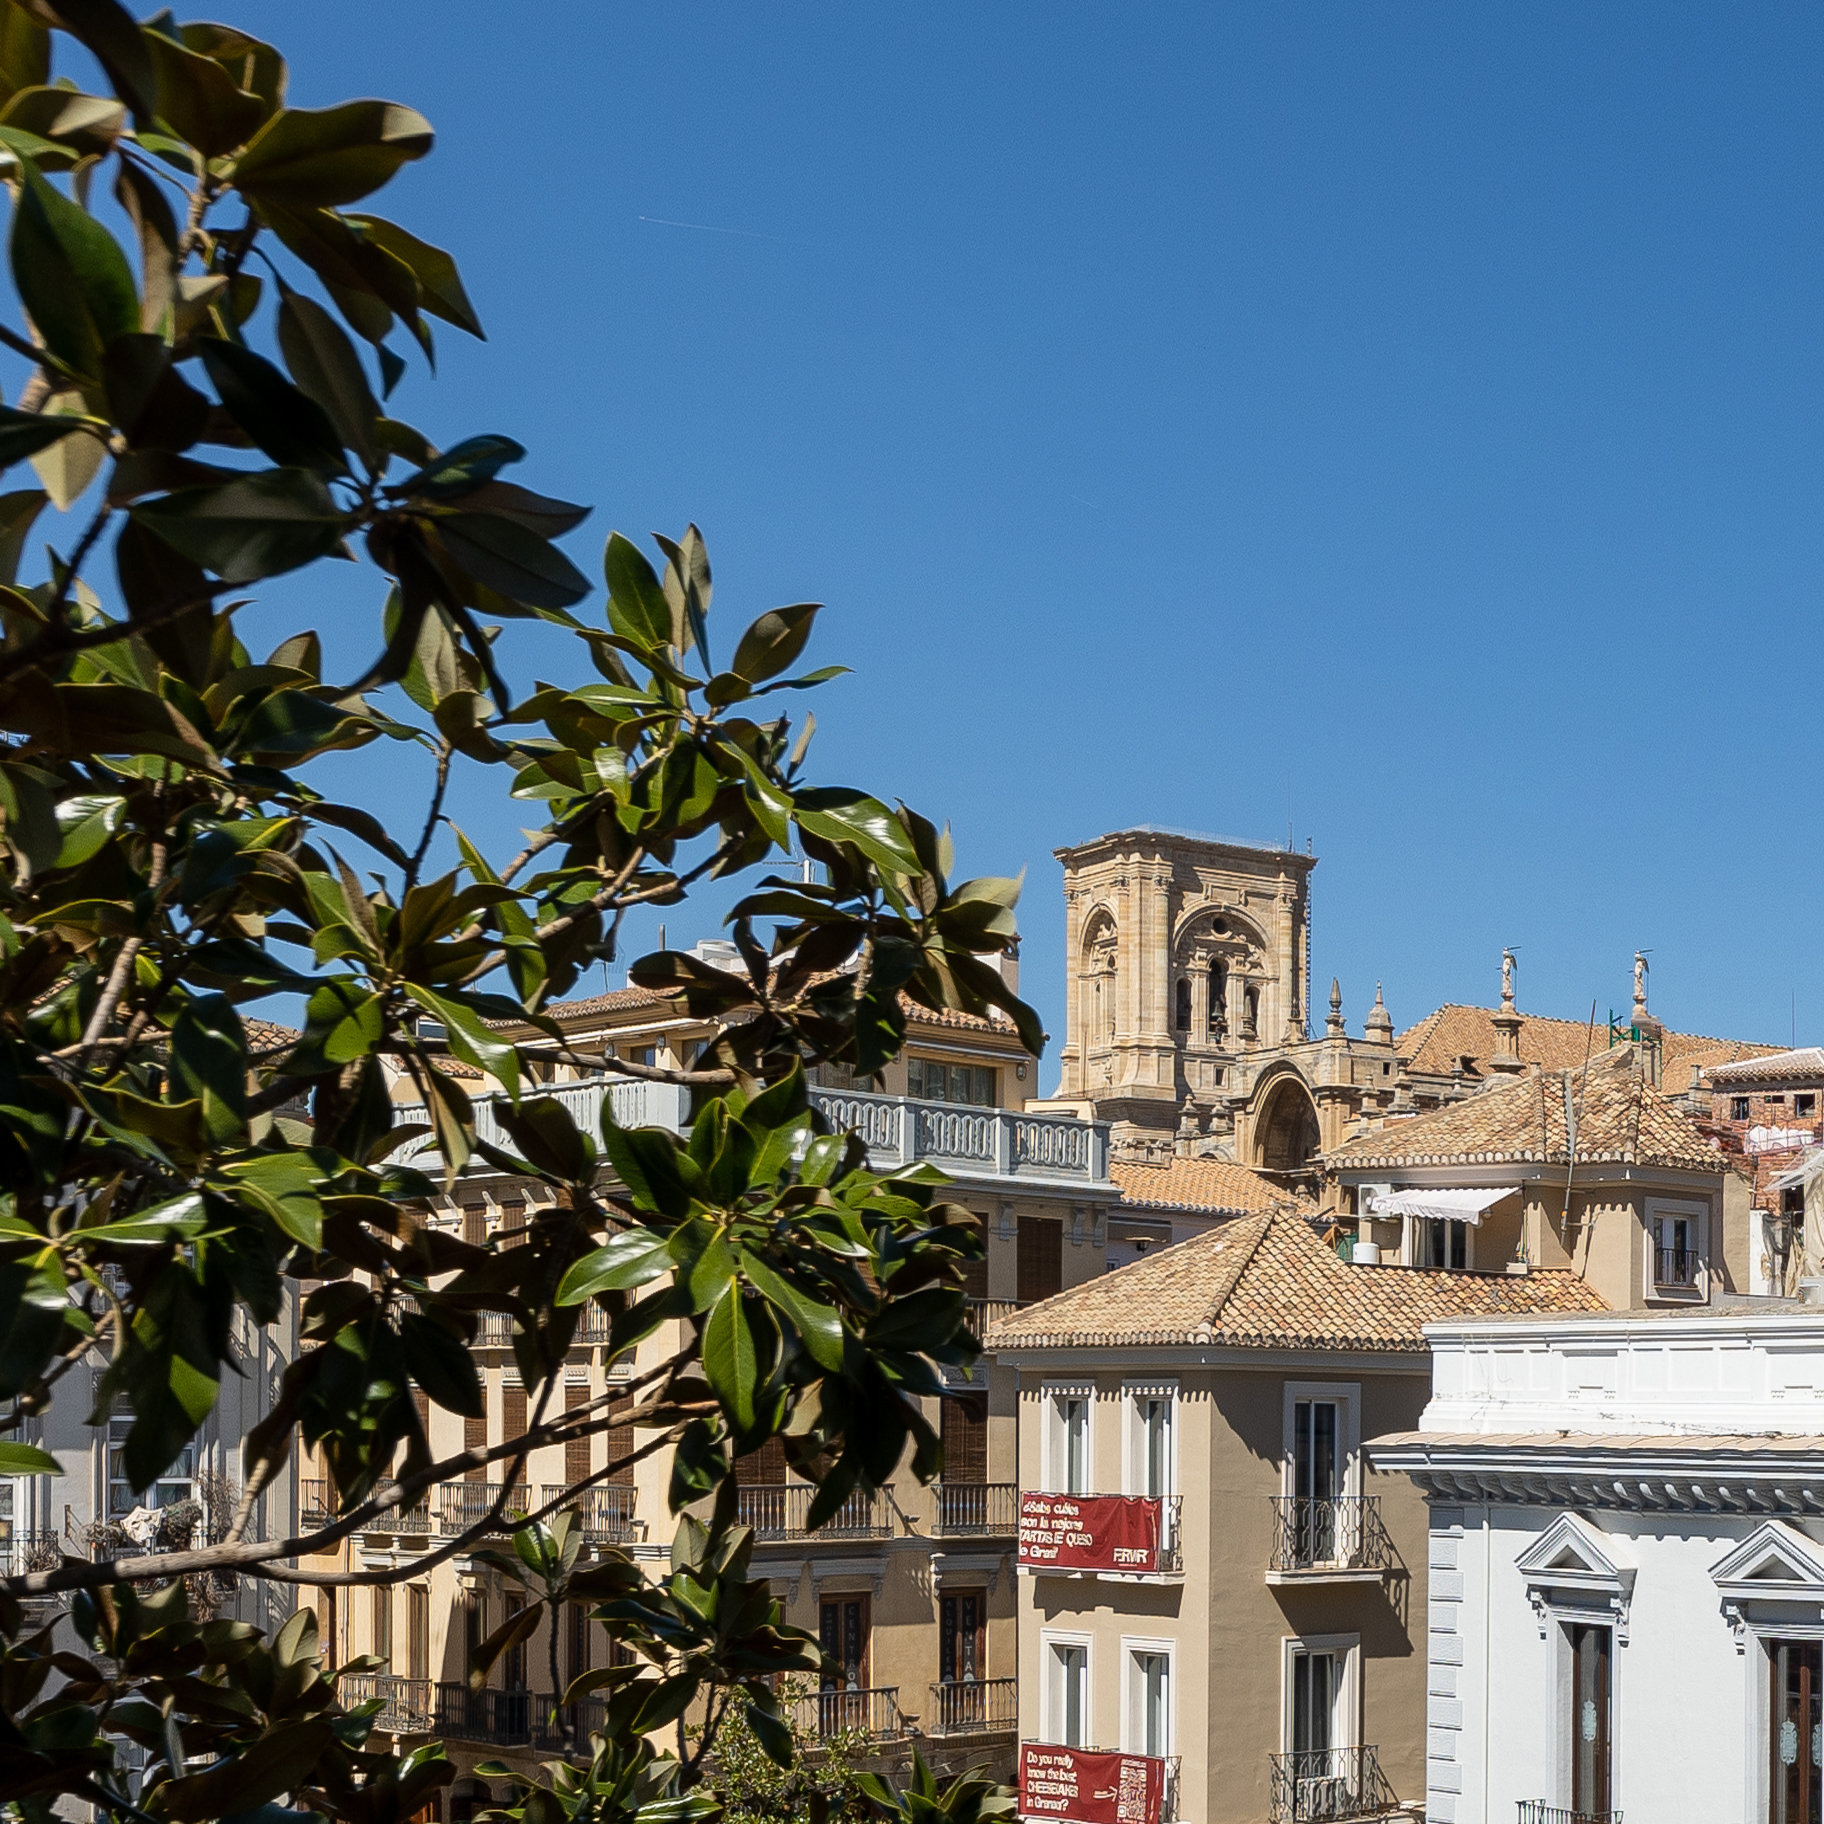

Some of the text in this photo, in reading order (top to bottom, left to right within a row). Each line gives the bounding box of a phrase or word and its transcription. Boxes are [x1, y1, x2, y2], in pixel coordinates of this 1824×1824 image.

[848, 1606, 856, 1681] CENTRO
[964, 1600, 973, 1672] VENTA
[1026, 1751, 1038, 1764] Do
[1038, 1754, 1053, 1767] you
[1026, 1796, 1034, 1808] in
